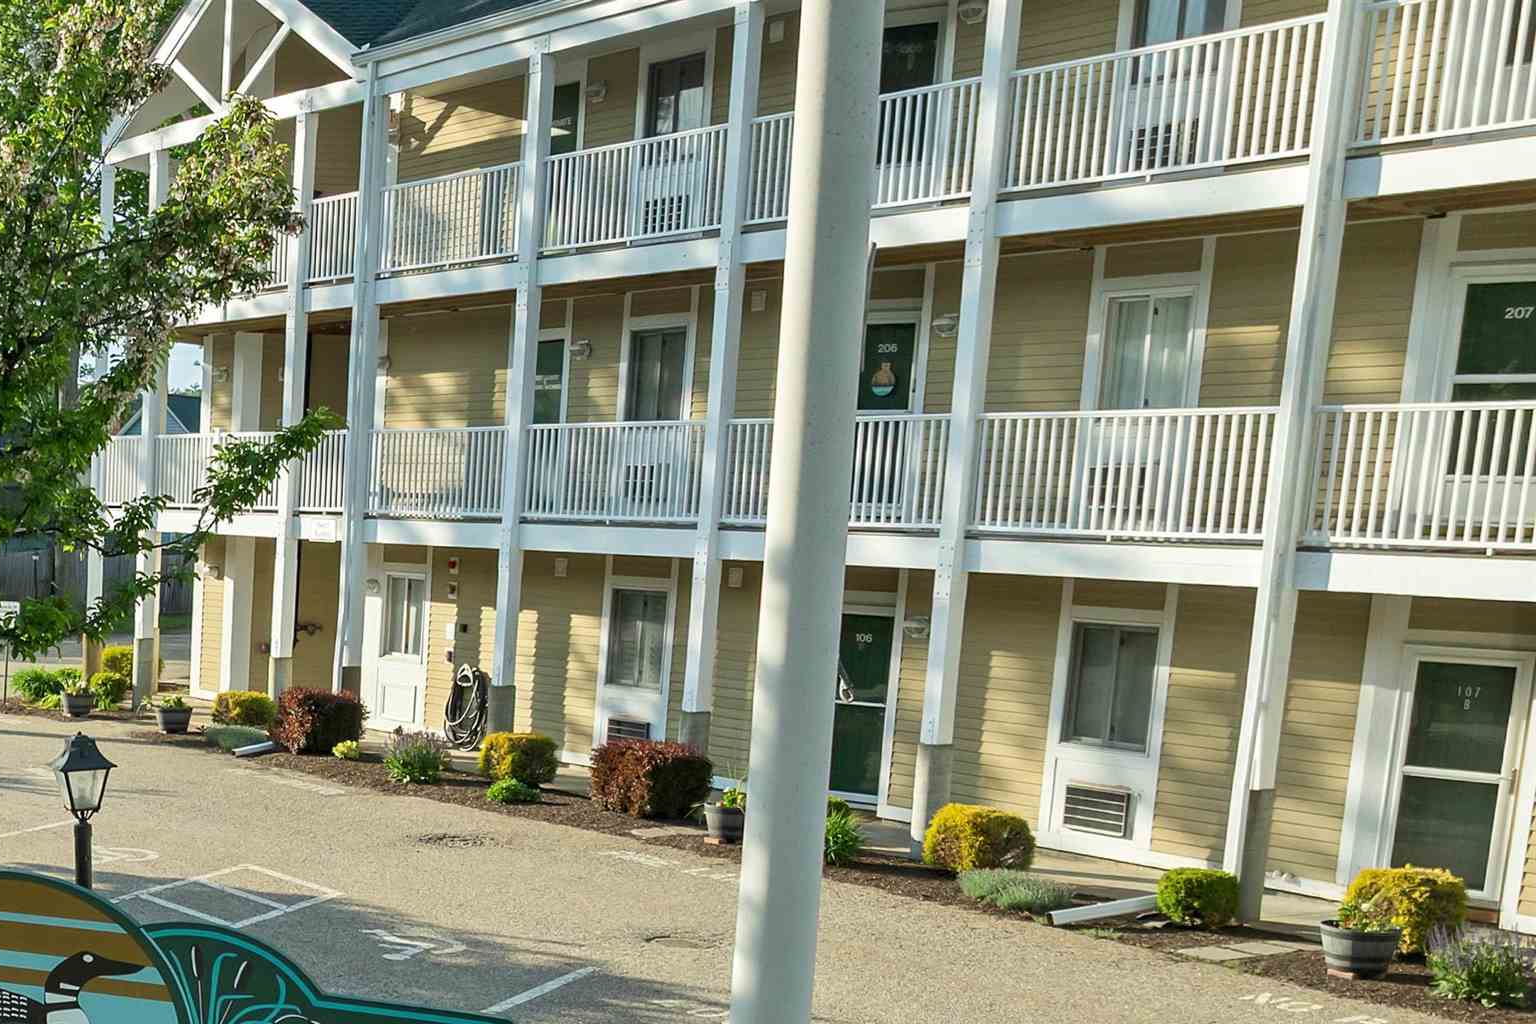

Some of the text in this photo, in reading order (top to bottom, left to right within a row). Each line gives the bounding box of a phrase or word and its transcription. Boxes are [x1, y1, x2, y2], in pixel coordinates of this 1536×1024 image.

[1504, 306, 1535, 319] 207
[878, 344, 898, 353] 206
[856, 633, 872, 643] 106
[1457, 685, 1480, 698] 107
[1238, 992, 1323, 1012] NO
